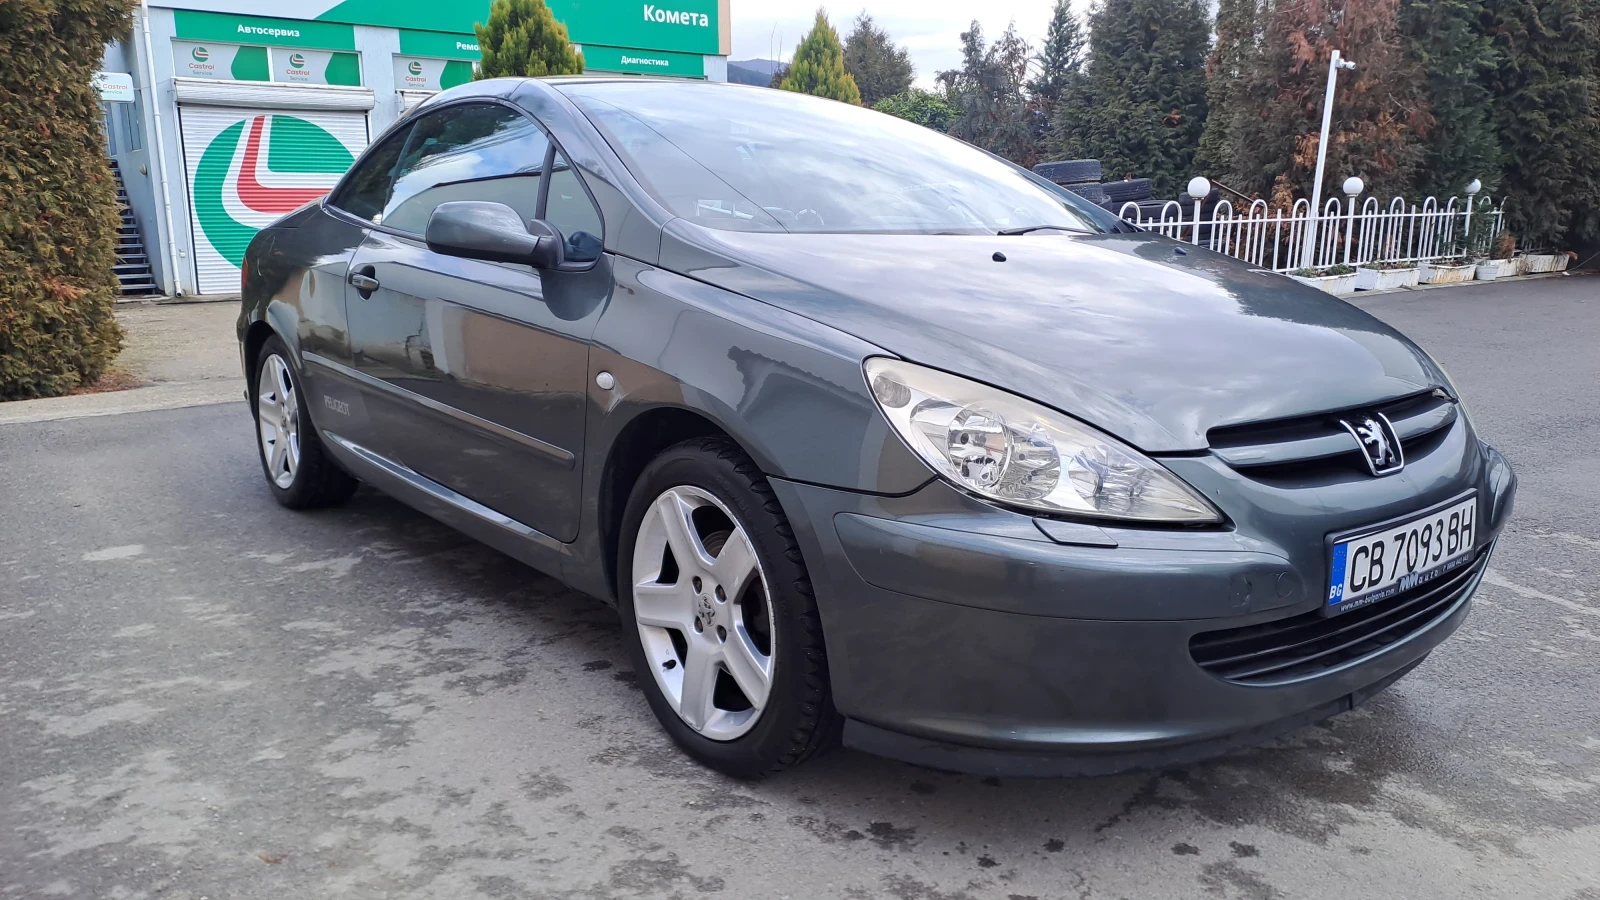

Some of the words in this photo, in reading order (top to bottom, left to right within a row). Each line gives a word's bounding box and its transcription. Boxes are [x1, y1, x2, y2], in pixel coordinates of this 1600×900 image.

[643, 4, 709, 28] Комета
[237, 24, 300, 38] Автосервиз
[621, 55, 669, 67] Диагностика
[324, 395, 351, 416] PEUGEOT
[1349, 541, 1385, 593] CB
[1389, 519, 1444, 581] 7093
[1447, 505, 1474, 556] BH
[1329, 585, 1343, 599] BG
